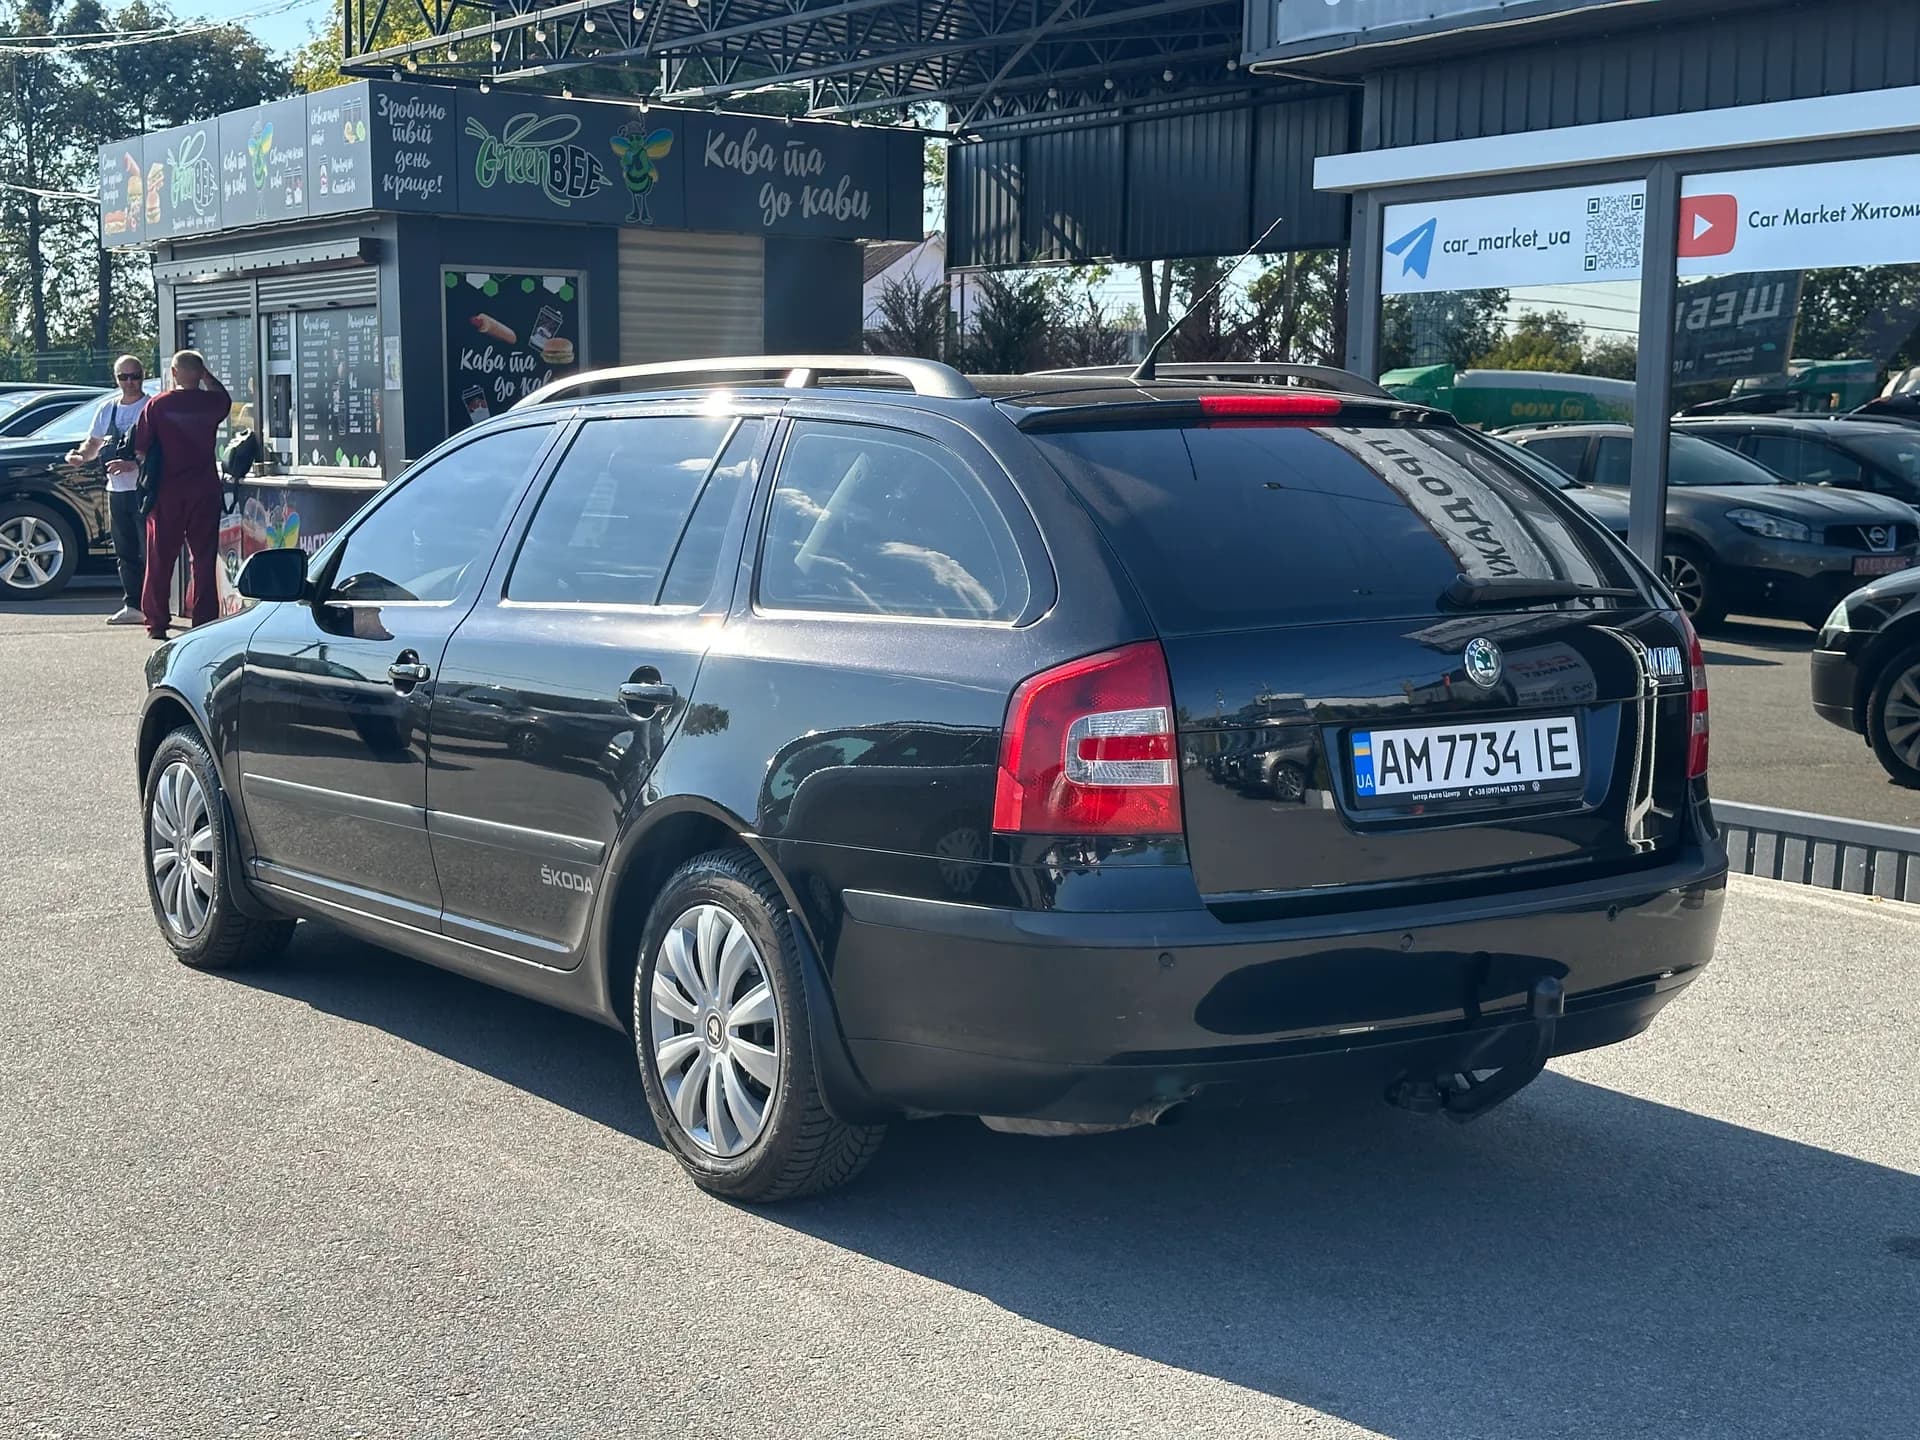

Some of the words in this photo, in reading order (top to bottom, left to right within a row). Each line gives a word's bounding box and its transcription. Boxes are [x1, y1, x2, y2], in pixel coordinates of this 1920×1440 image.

[377, 93, 447, 125] Зробимо
[392, 119, 433, 145] твій
[394, 150, 431, 174] день
[704, 127, 777, 176] Кава
[783, 140, 826, 178] та
[381, 173, 443, 201] краще!
[759, 182, 792, 226] до
[799, 174, 872, 221] кави
[1748, 210, 1779, 229] Car
[1783, 204, 1847, 226] Market
[1442, 227, 1571, 256] car_market_ua
[459, 345, 506, 374] Кава
[509, 351, 536, 373] та
[494, 376, 516, 401] до
[1356, 774, 1375, 789] UA
[540, 863, 594, 896] ŠKODA
